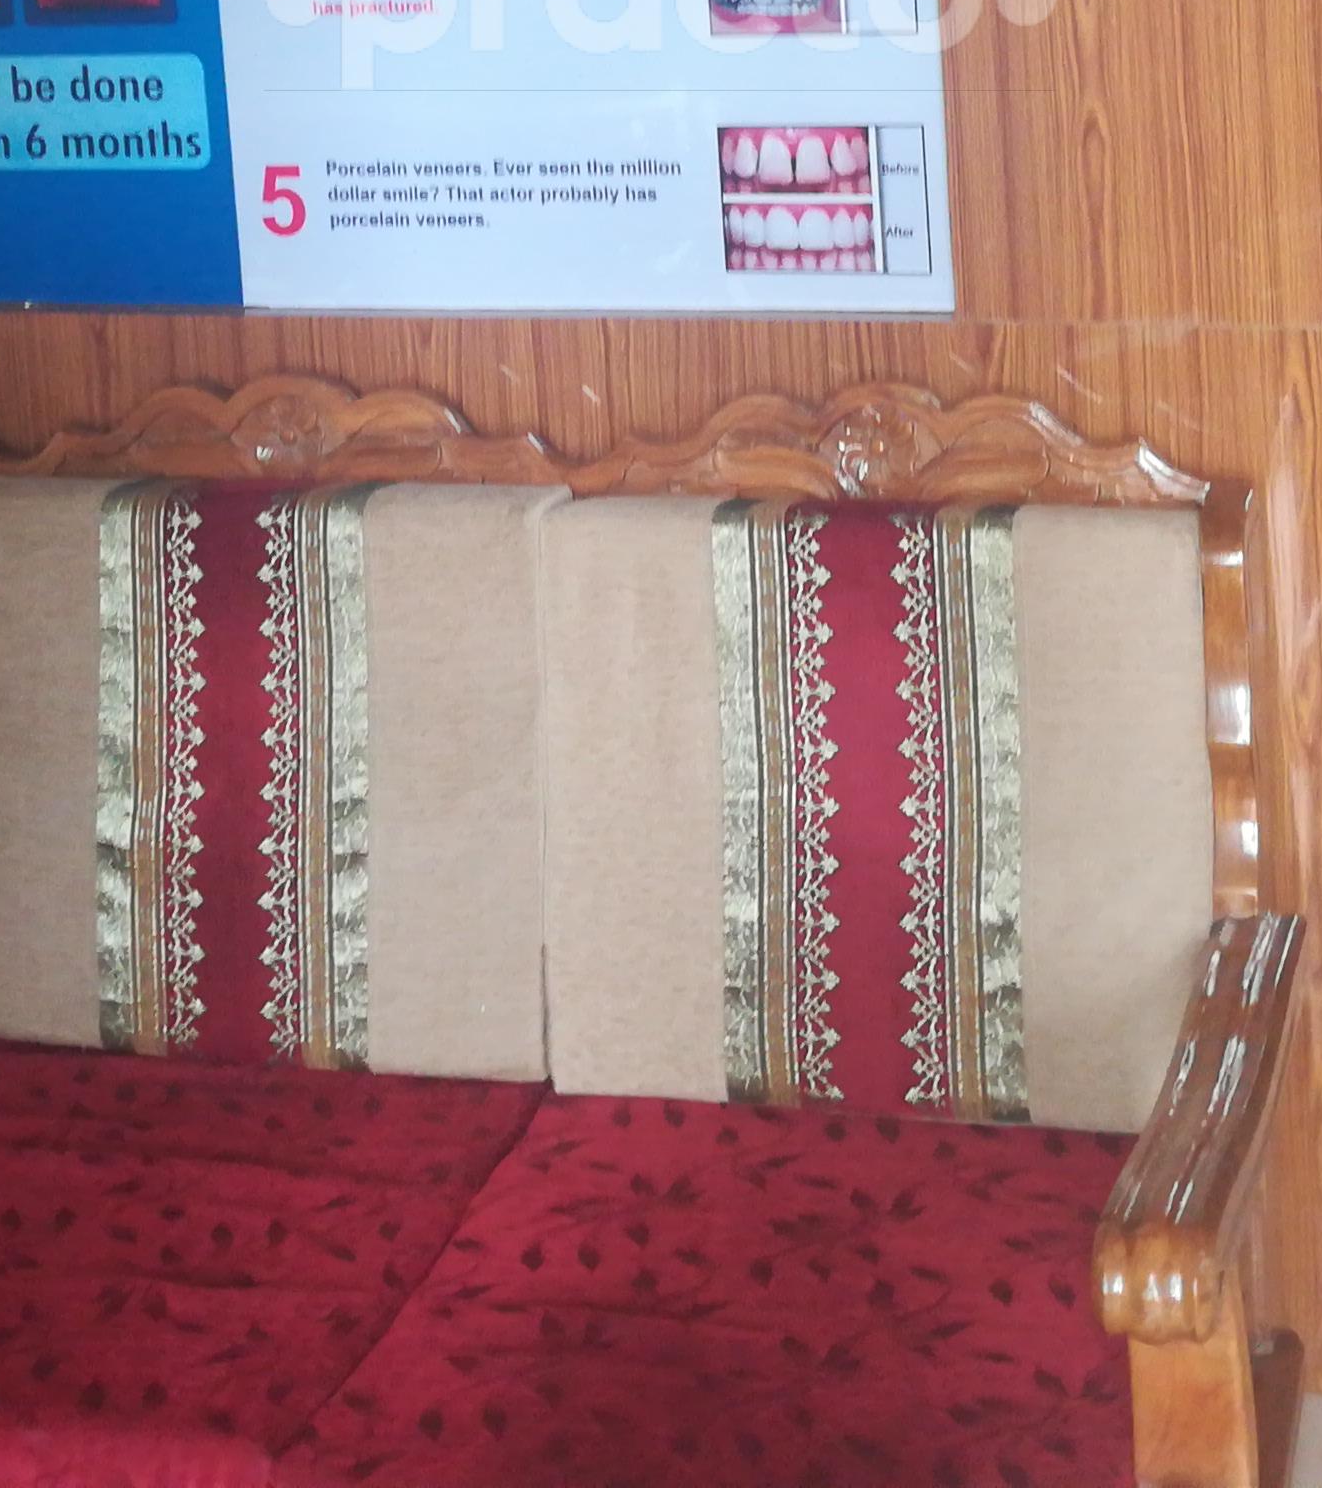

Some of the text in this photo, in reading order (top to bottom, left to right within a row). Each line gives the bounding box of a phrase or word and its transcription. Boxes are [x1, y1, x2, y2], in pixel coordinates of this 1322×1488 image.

[9, 62, 56, 103] be
[69, 57, 163, 103] done
[25, 121, 48, 160] 6
[61, 118, 202, 160] months
[325, 160, 408, 178] Porcelain
[493, 160, 533, 177] Ever
[538, 160, 581, 177] seen
[587, 160, 614, 176] the
[619, 159, 682, 176] million
[262, 164, 307, 237] 5
[328, 184, 657, 205] dollar smile? That actor probably has
[329, 211, 410, 231] porcelain
